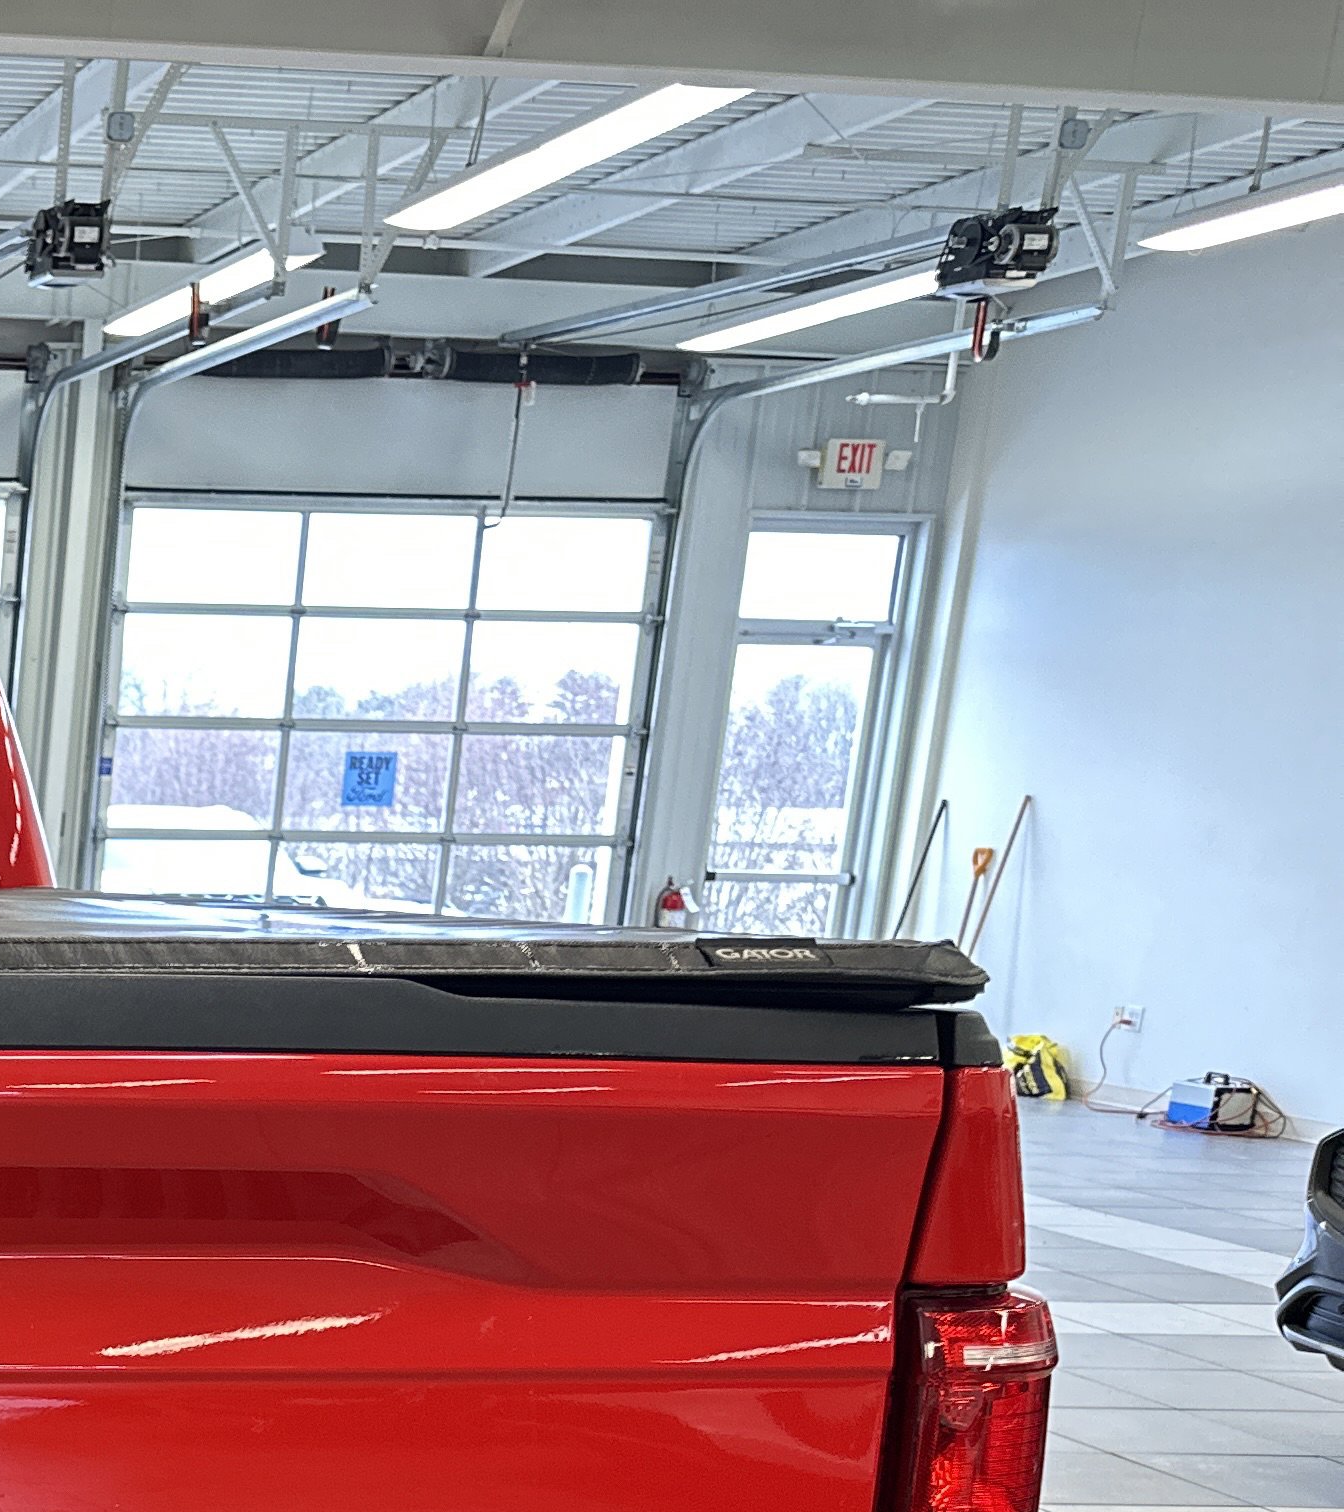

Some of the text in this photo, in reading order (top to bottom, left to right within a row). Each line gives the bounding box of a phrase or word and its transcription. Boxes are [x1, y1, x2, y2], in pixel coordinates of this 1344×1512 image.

[836, 443, 876, 474] EXIT
[350, 756, 392, 770] READY
[357, 770, 380, 785] SET
[715, 948, 815, 960] GATOR
